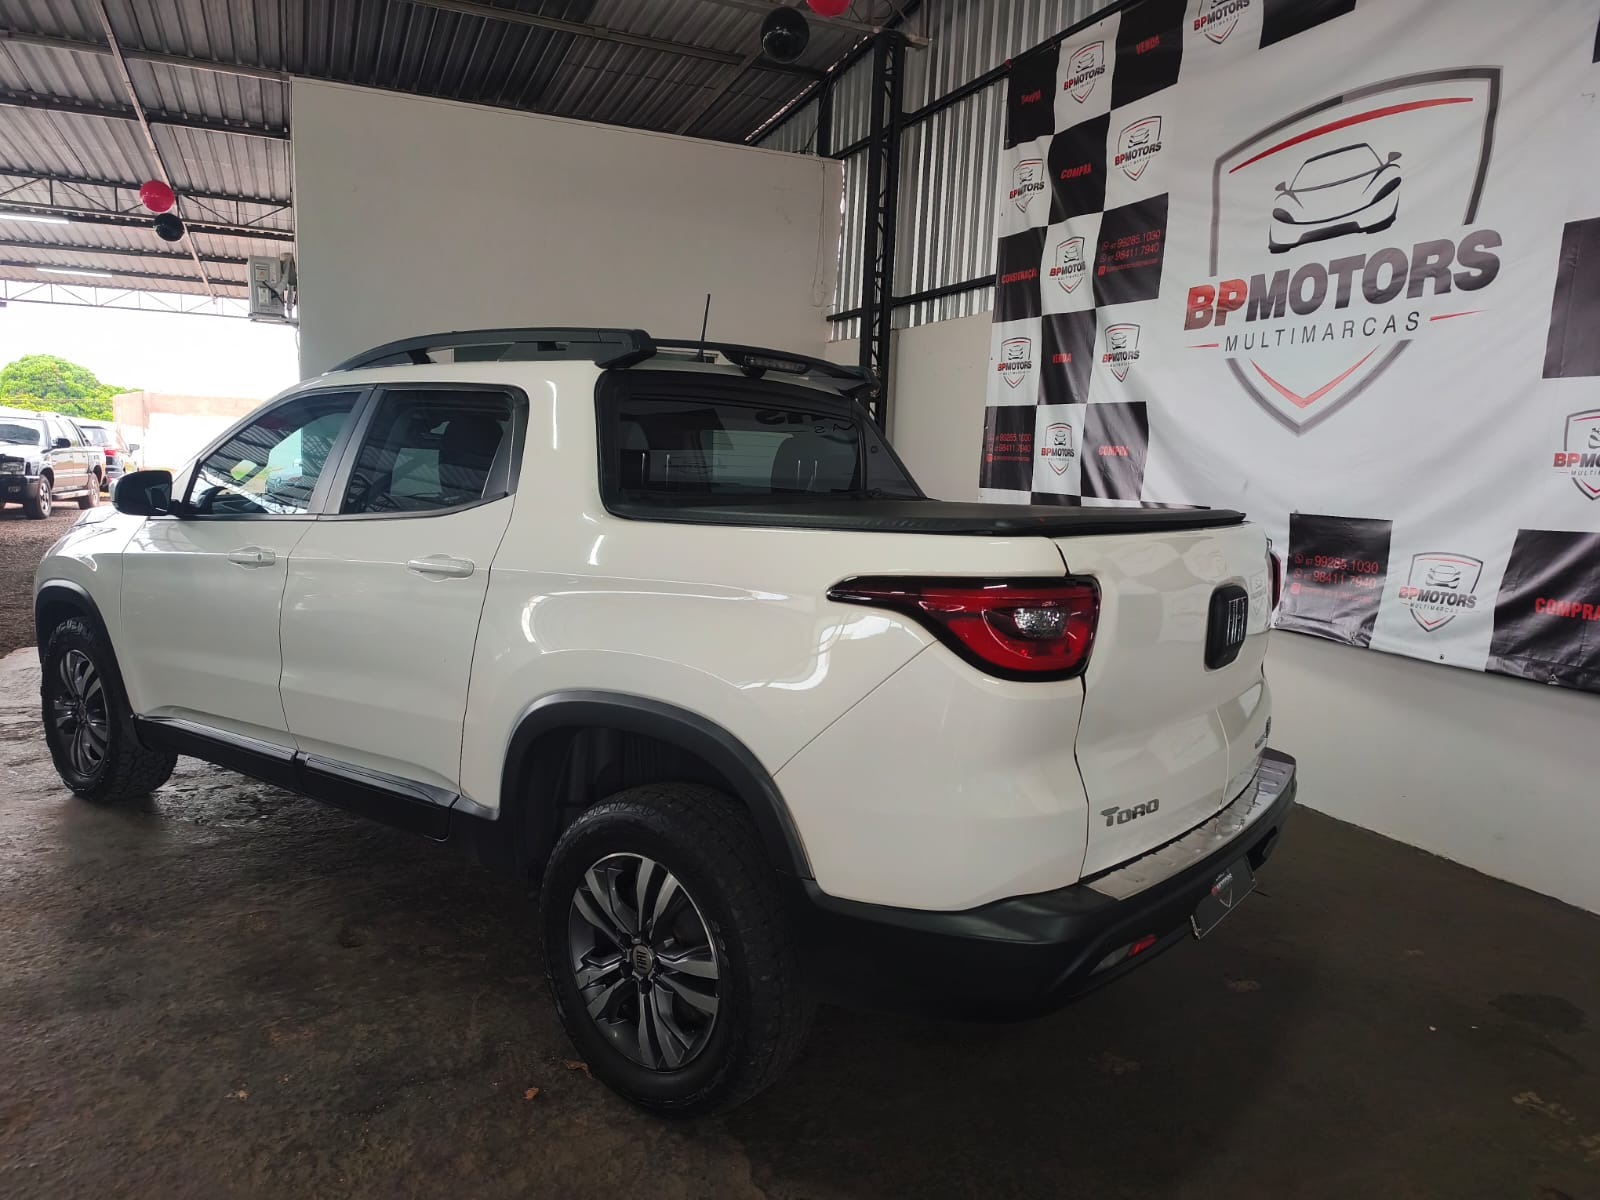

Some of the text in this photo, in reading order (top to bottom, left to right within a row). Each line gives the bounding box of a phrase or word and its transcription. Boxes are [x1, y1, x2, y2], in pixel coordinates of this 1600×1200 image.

[1193, 0, 1249, 31] BPMOTORS
[1063, 65, 1105, 91] BPMOTORS
[1114, 142, 1162, 166] BPMOTORS
[1009, 181, 1045, 199] BPMTORS
[1049, 261, 1086, 277] BPMOTO
[1184, 229, 1503, 330] BPMOTORS
[1225, 311, 1419, 352] MULTIMARCAS
[997, 361, 1032, 372] BPMOTORS
[1041, 447, 1075, 458] BPMOTORS
[1398, 586, 1478, 609] BPMOTORS
[1100, 799, 1160, 827] TORO
